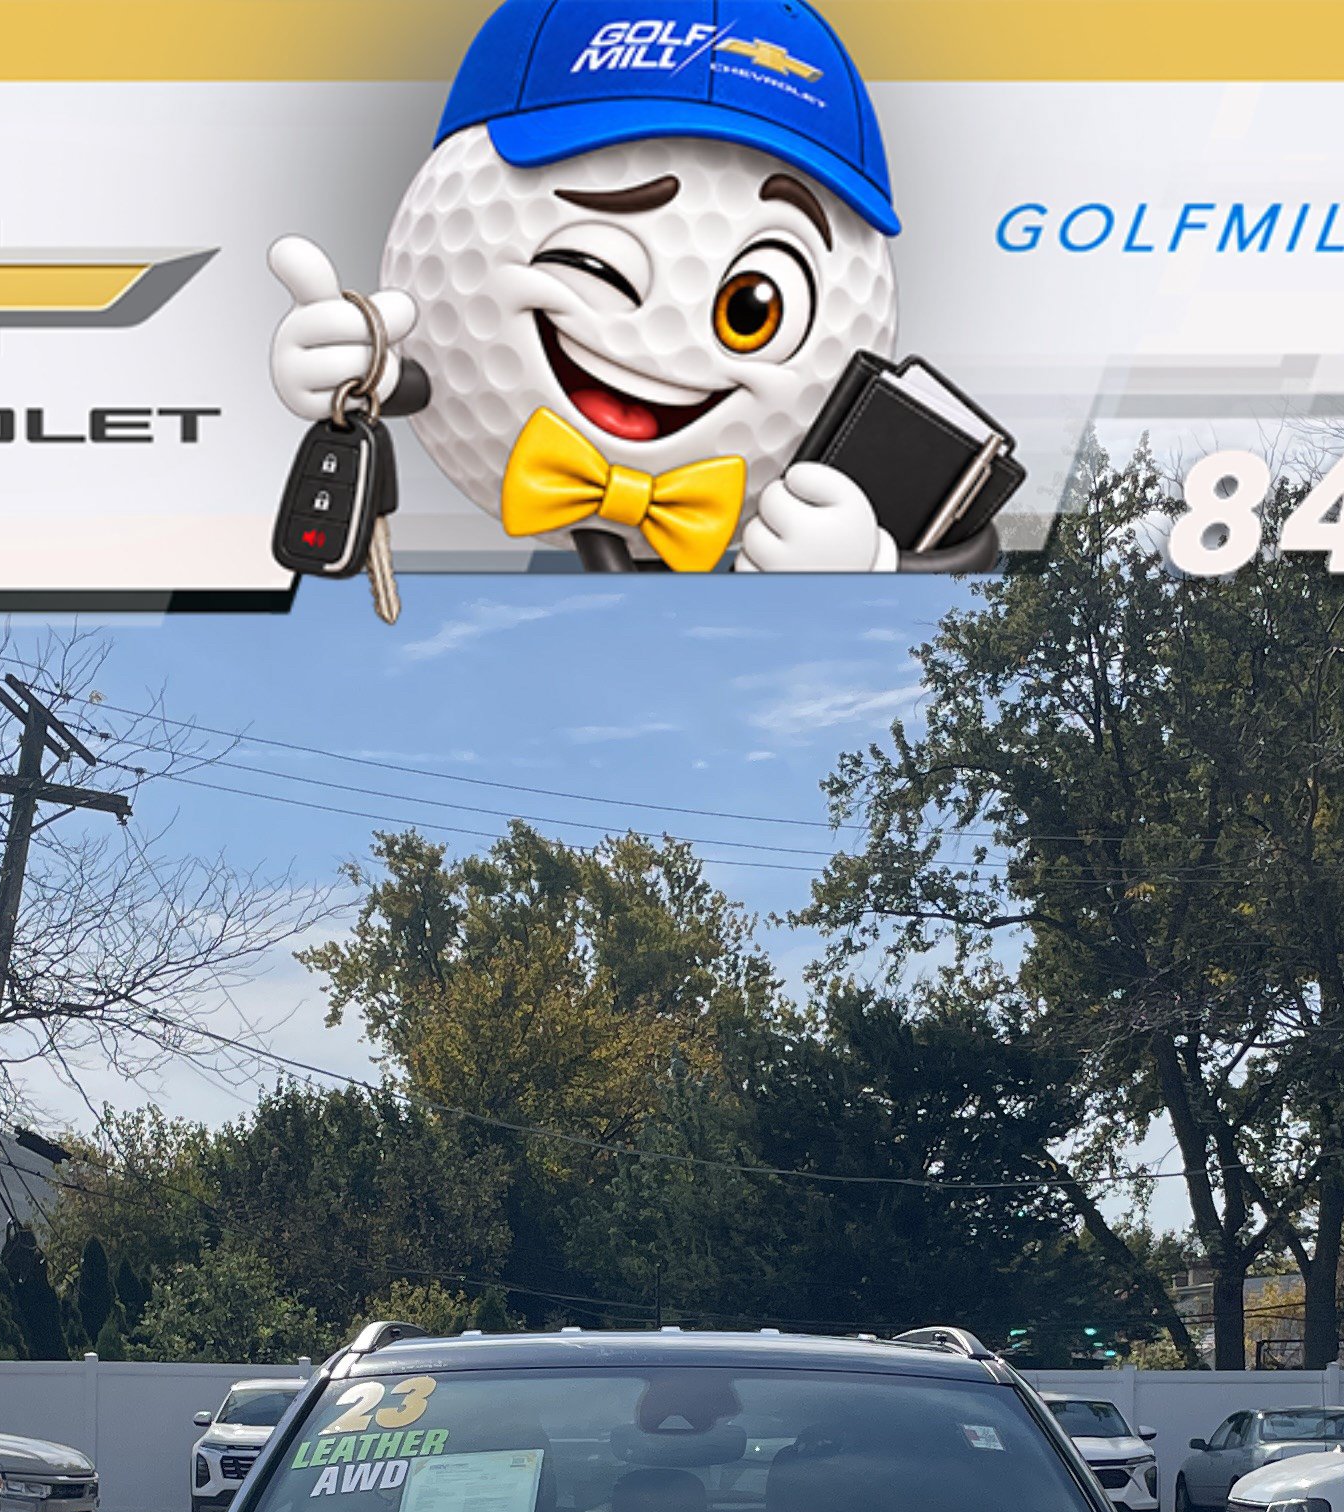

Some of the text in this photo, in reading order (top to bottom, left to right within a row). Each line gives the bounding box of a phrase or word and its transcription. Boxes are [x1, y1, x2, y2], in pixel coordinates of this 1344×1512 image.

[318, 1375, 437, 1435] 23
[291, 1428, 450, 1469] LEATHER
[310, 1459, 409, 1498] AWD
